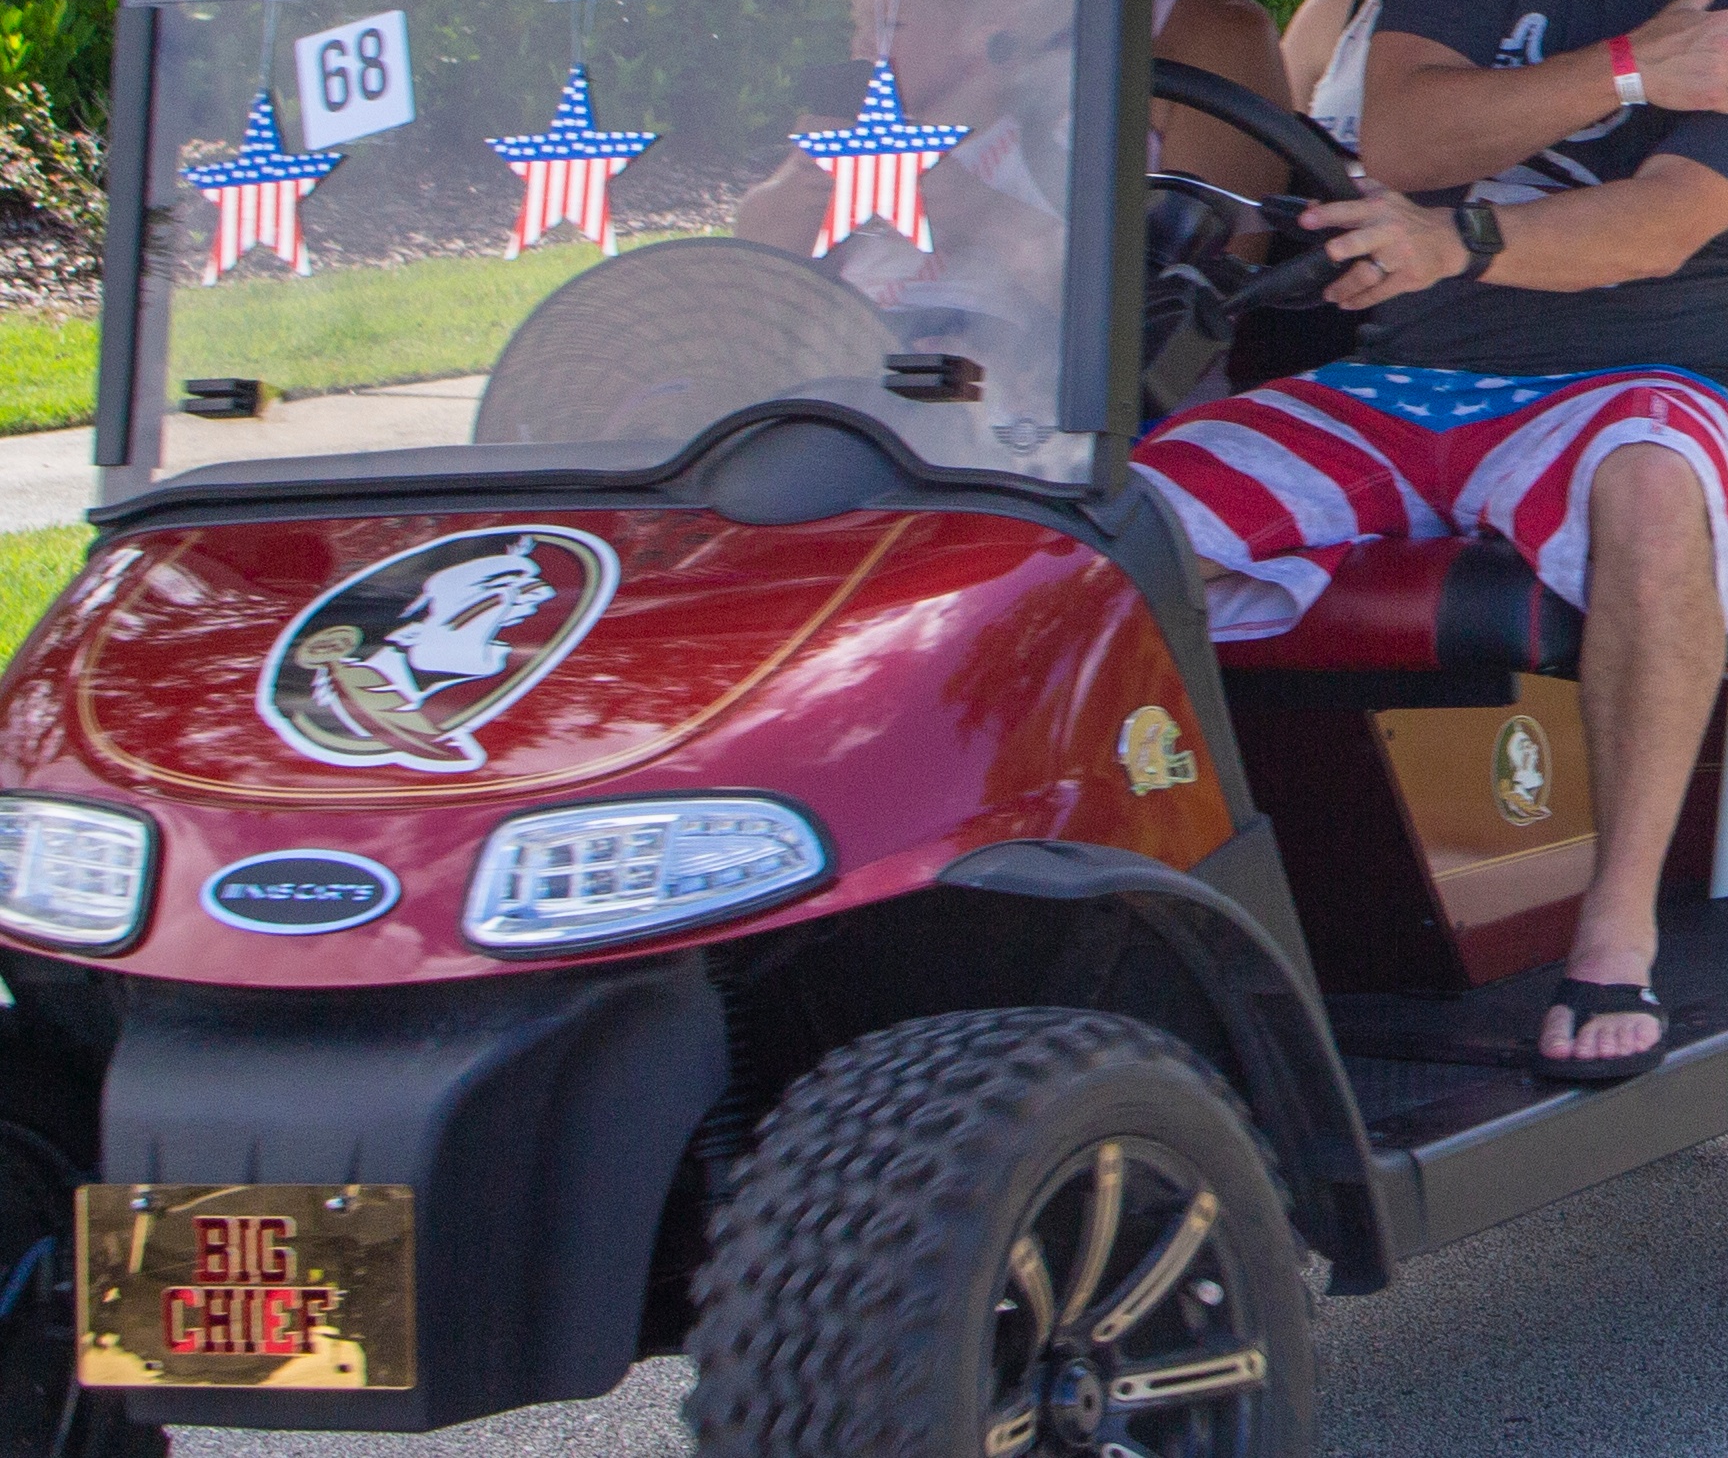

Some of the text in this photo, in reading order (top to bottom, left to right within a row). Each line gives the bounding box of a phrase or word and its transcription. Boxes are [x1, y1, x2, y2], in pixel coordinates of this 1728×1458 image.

[318, 27, 388, 113] 68
[193, 1216, 298, 1283] BIG
[161, 1286, 344, 1355] CHIEF
